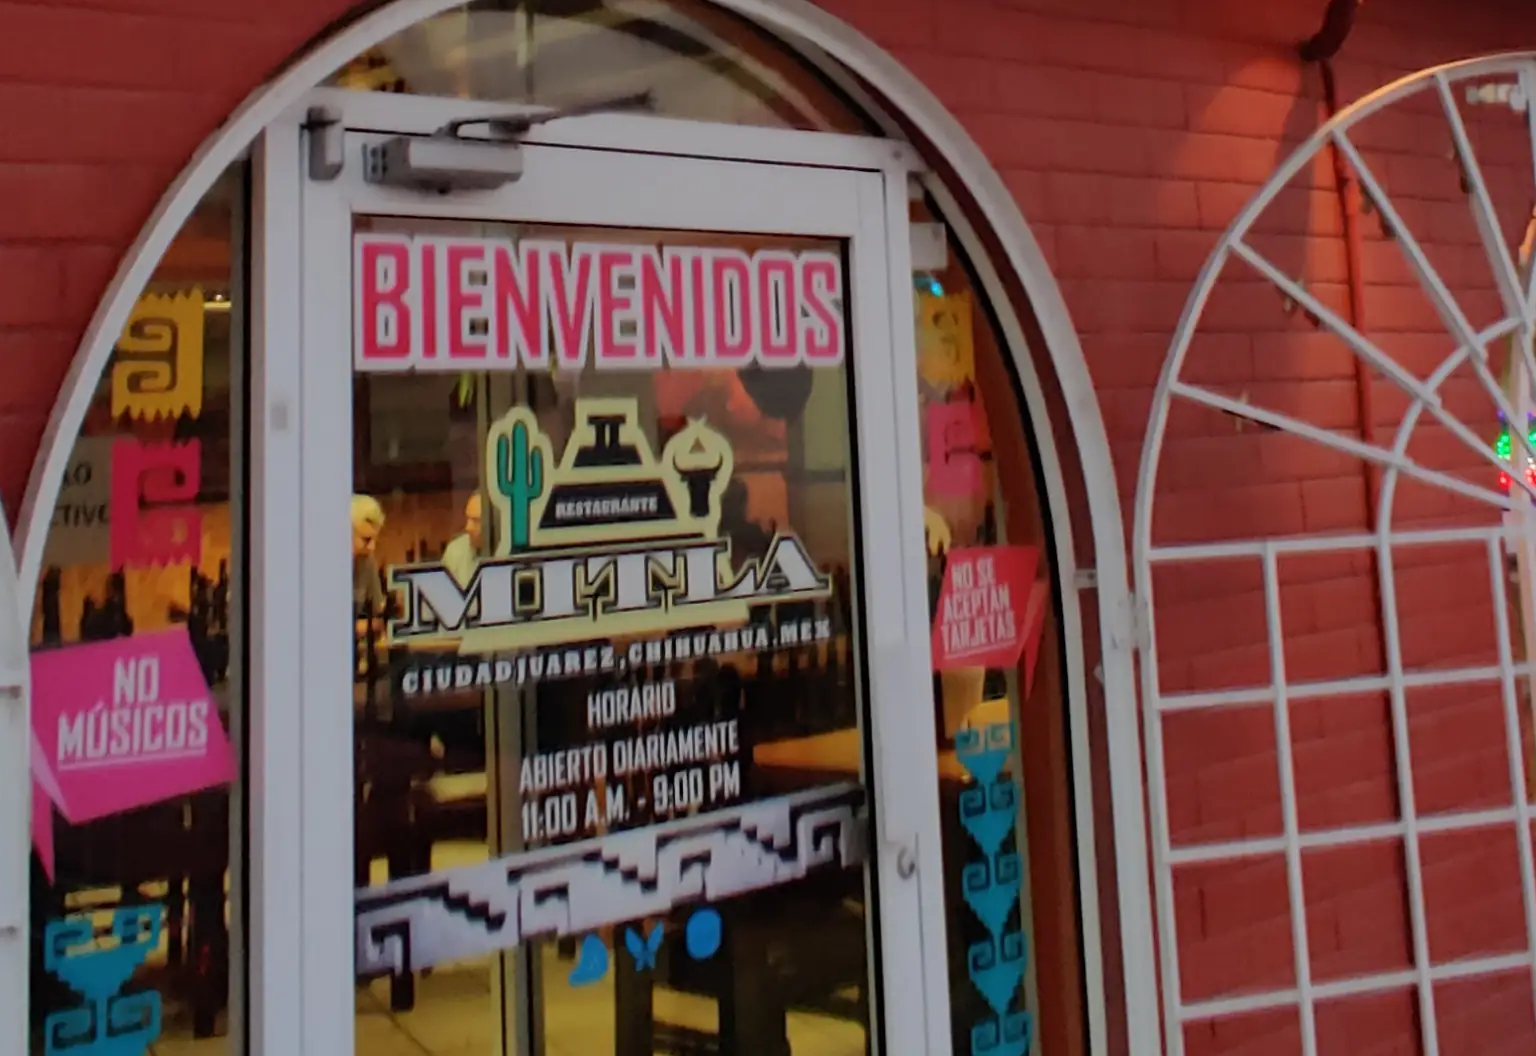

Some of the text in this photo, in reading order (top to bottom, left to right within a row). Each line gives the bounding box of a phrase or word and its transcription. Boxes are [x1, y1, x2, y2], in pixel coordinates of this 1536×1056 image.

[358, 239, 842, 364] BIENVENIDOS
[555, 495, 658, 519] RESTAURANTE
[394, 532, 830, 635] MITLA
[951, 555, 995, 589] NO SE
[943, 583, 1011, 622] ACEPTAN
[940, 609, 1016, 653] TARJETAS
[114, 655, 160, 704] NO
[587, 681, 677, 729] HORARIO
[57, 700, 209, 761] MÚSICOS
[519, 719, 740, 794] ABIERTO DIARIAMENTE
[521, 793, 578, 841] 11:00
[653, 767, 704, 815] 9:00
[709, 761, 741, 802] PM
